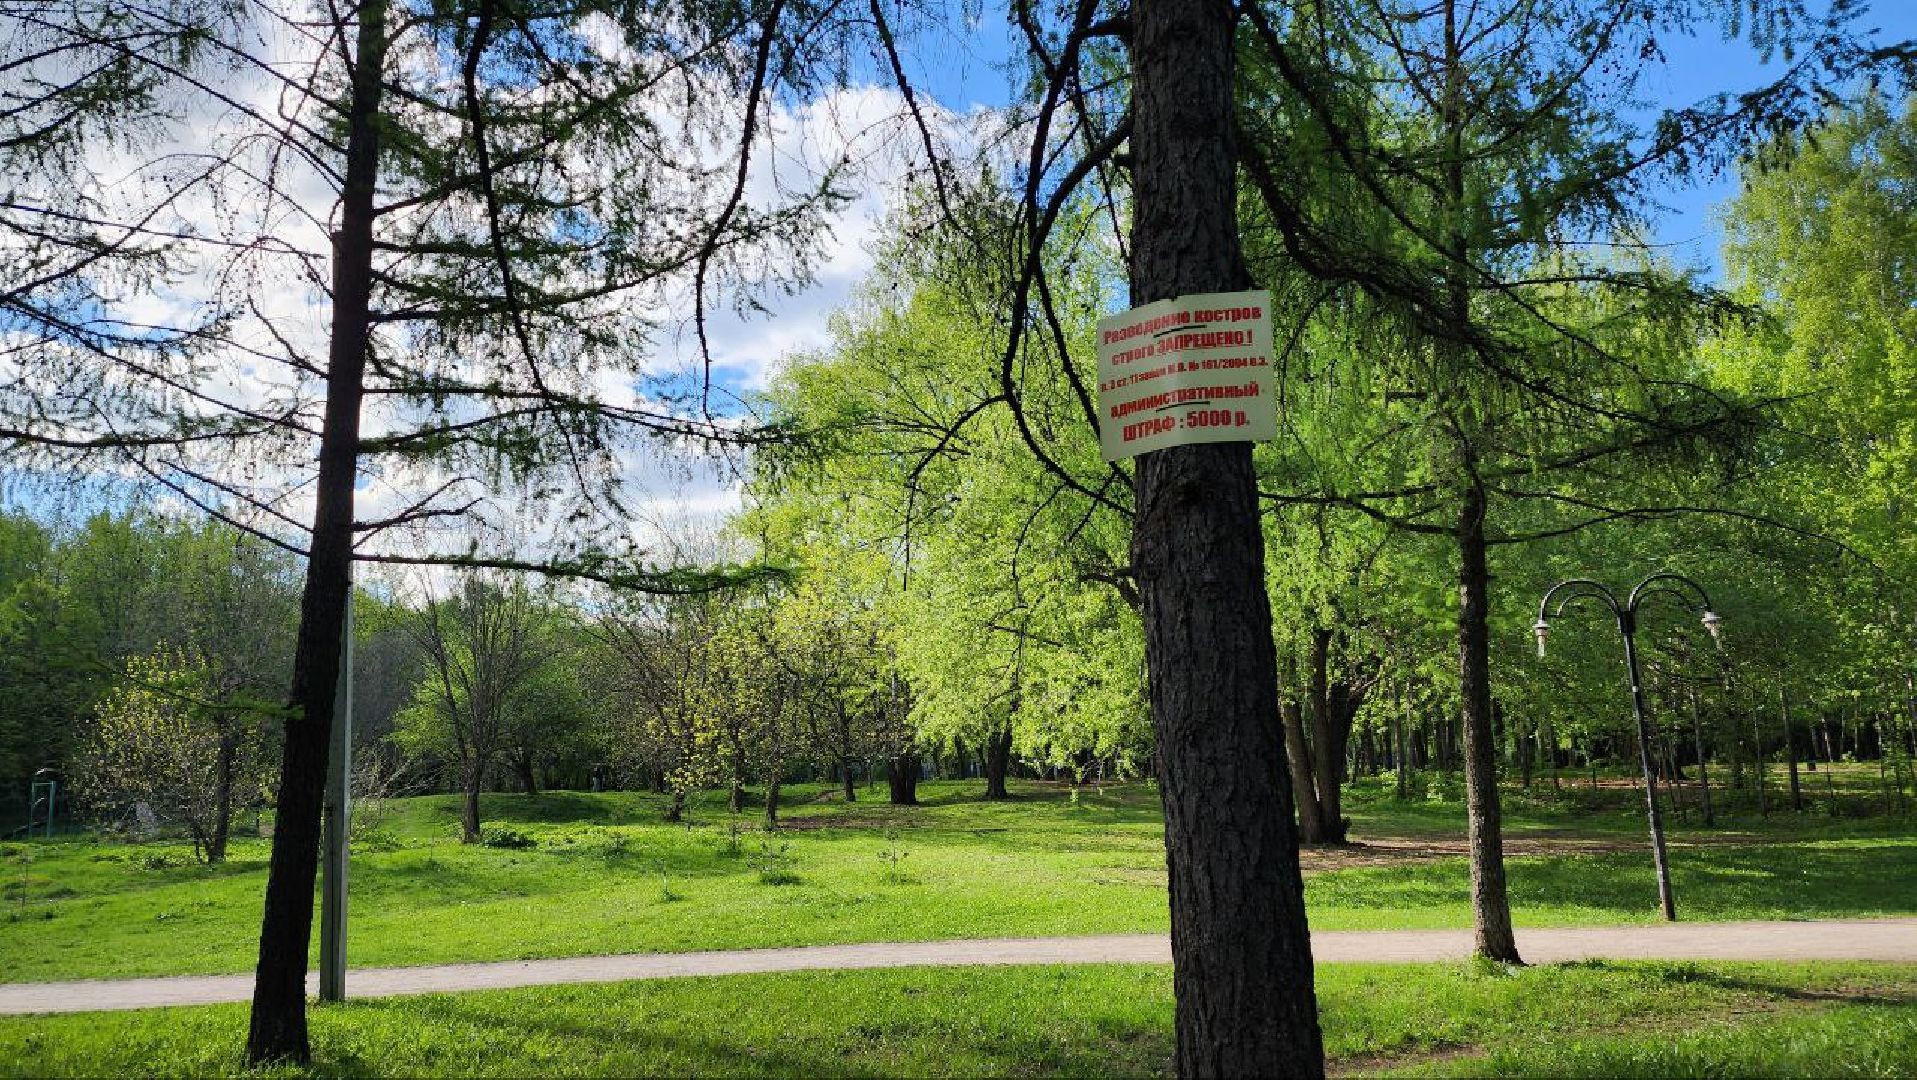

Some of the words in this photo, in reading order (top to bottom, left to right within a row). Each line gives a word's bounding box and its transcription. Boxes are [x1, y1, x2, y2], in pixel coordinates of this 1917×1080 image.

[1194, 306, 1262, 322] костров
[1111, 345, 1154, 366] строго
[1158, 331, 1244, 355] ЗАПРЕЩЕНО
[1111, 380, 1259, 418] административный
[1123, 415, 1175, 442] ШТРАФ
[1187, 410, 1231, 428] 5000
